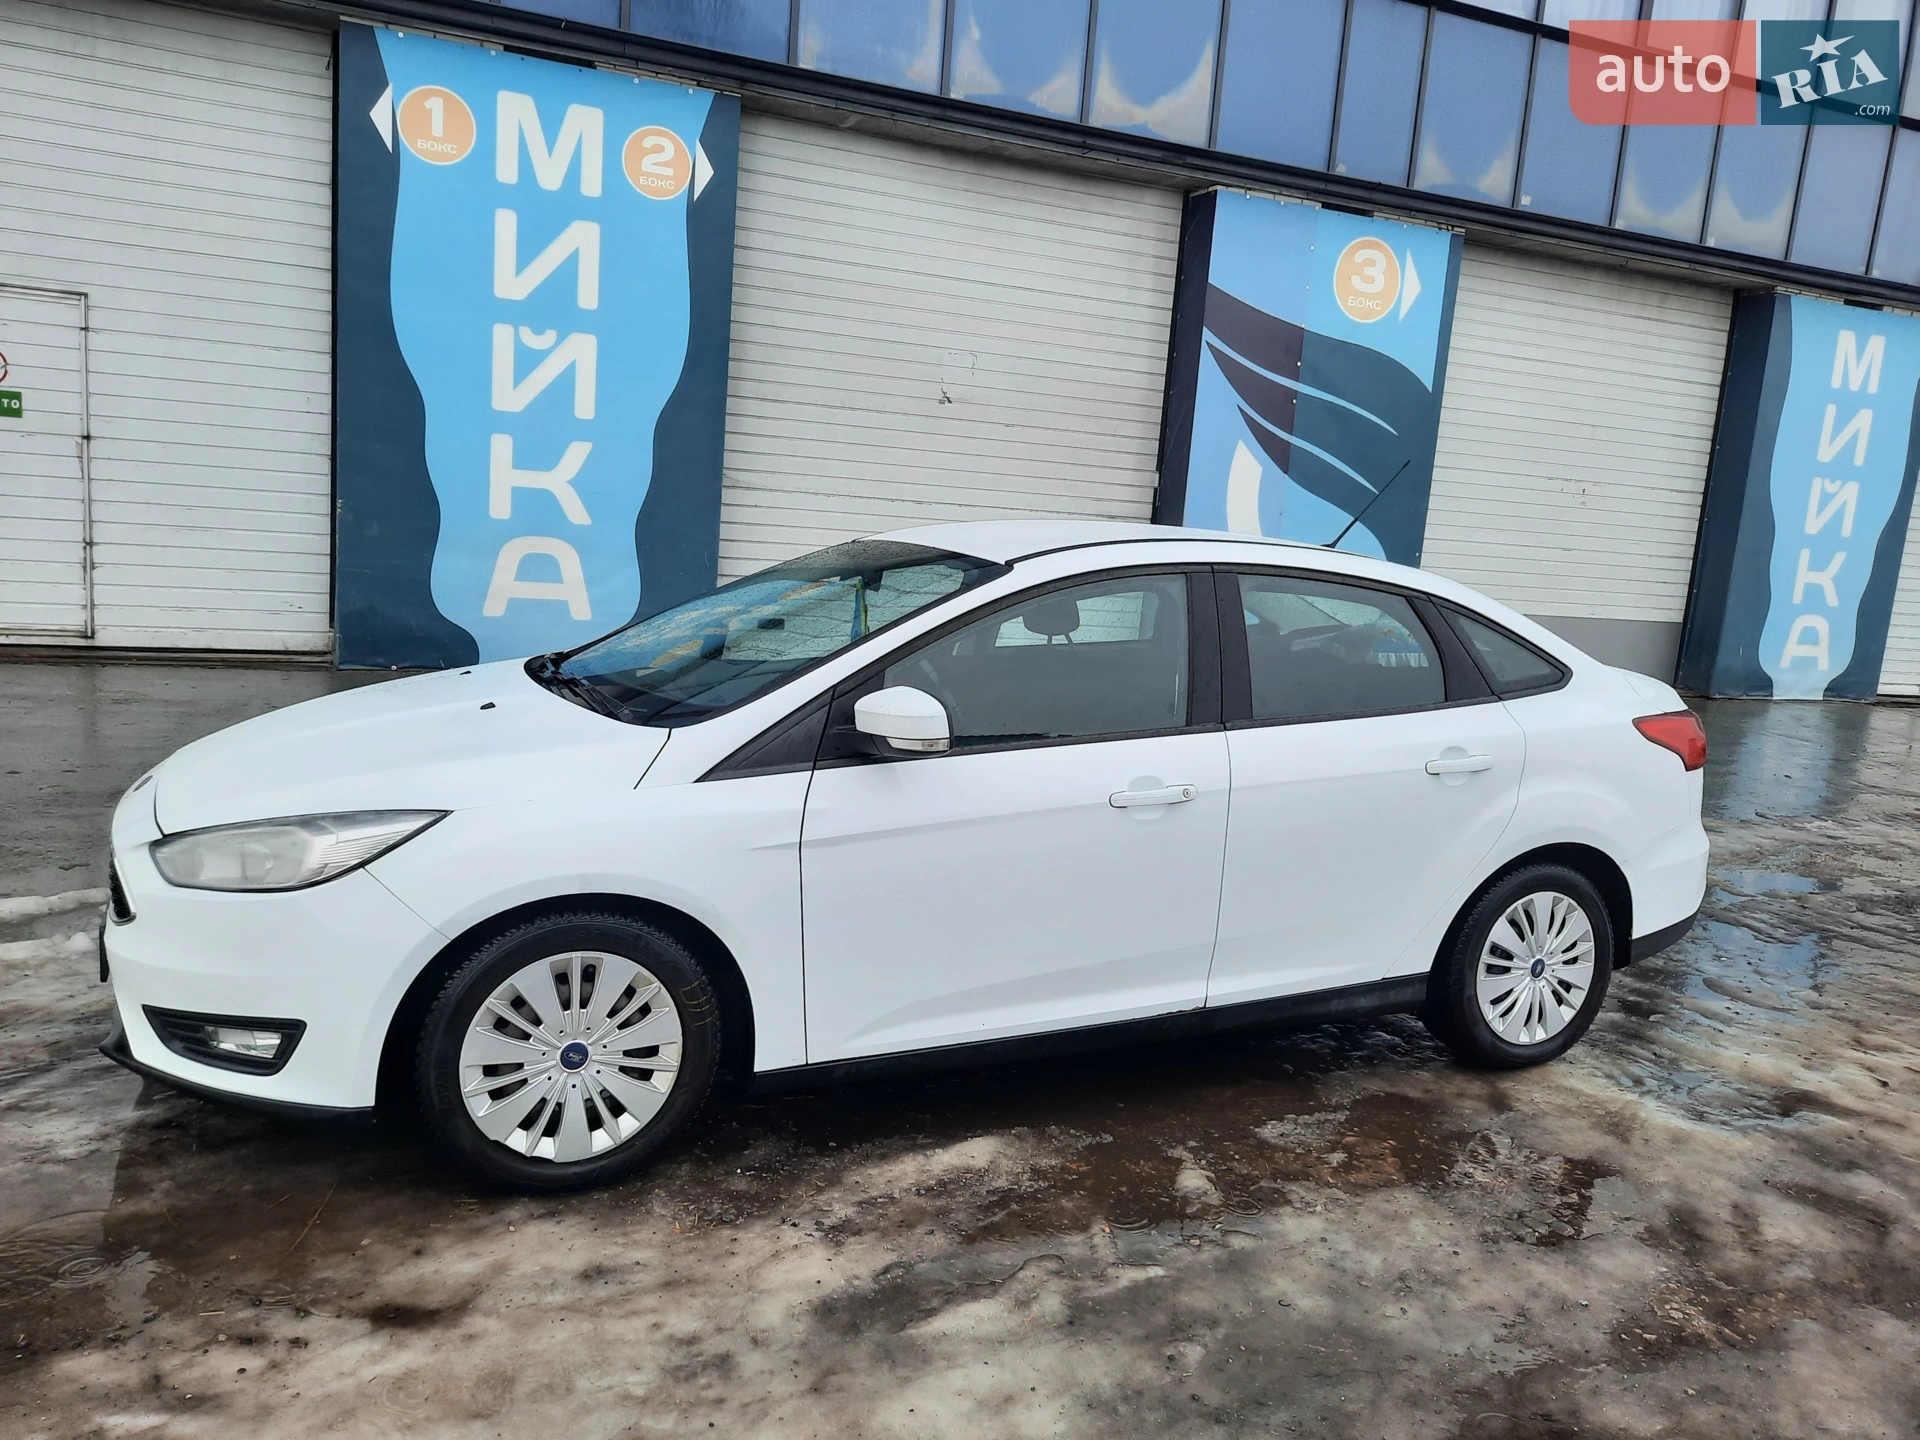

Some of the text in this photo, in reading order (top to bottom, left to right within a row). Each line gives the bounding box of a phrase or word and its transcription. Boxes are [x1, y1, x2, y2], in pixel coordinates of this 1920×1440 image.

[423, 96, 444, 138] 1
[416, 138, 458, 154] БОКС
[641, 135, 675, 176] 2
[639, 175, 676, 190] БОКС
[1350, 248, 1387, 294] 3
[1347, 295, 1383, 310] БОКС
[483, 90, 604, 621] МИЙКА
[1779, 329, 1886, 671] МИЙКА
